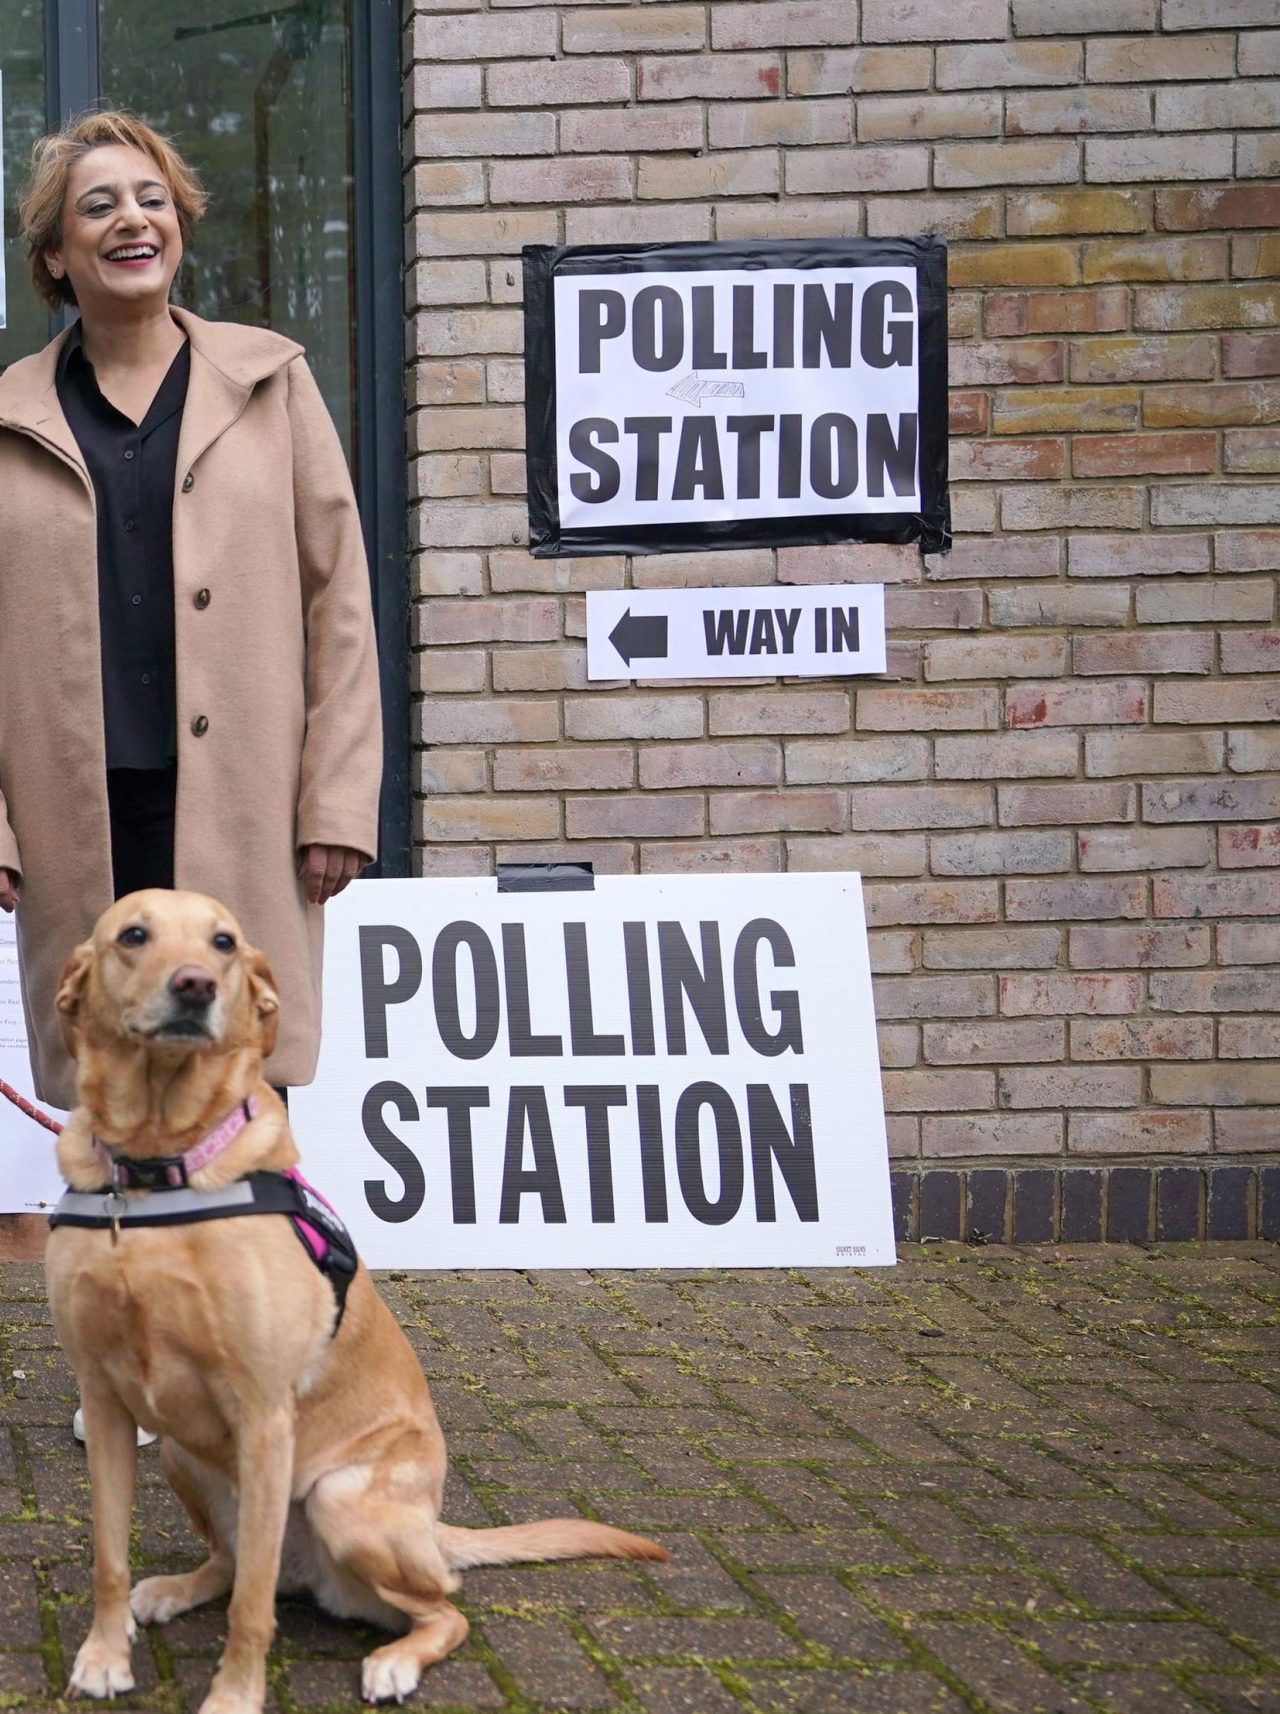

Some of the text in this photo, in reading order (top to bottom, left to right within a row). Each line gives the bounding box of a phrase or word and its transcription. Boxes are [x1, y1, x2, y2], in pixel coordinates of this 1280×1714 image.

[578, 280, 914, 374] POLLING
[568, 412, 918, 504] STATION
[702, 606, 860, 656] WAY IN
[358, 917, 804, 1060] POLLING
[361, 1080, 820, 1226] STATION
